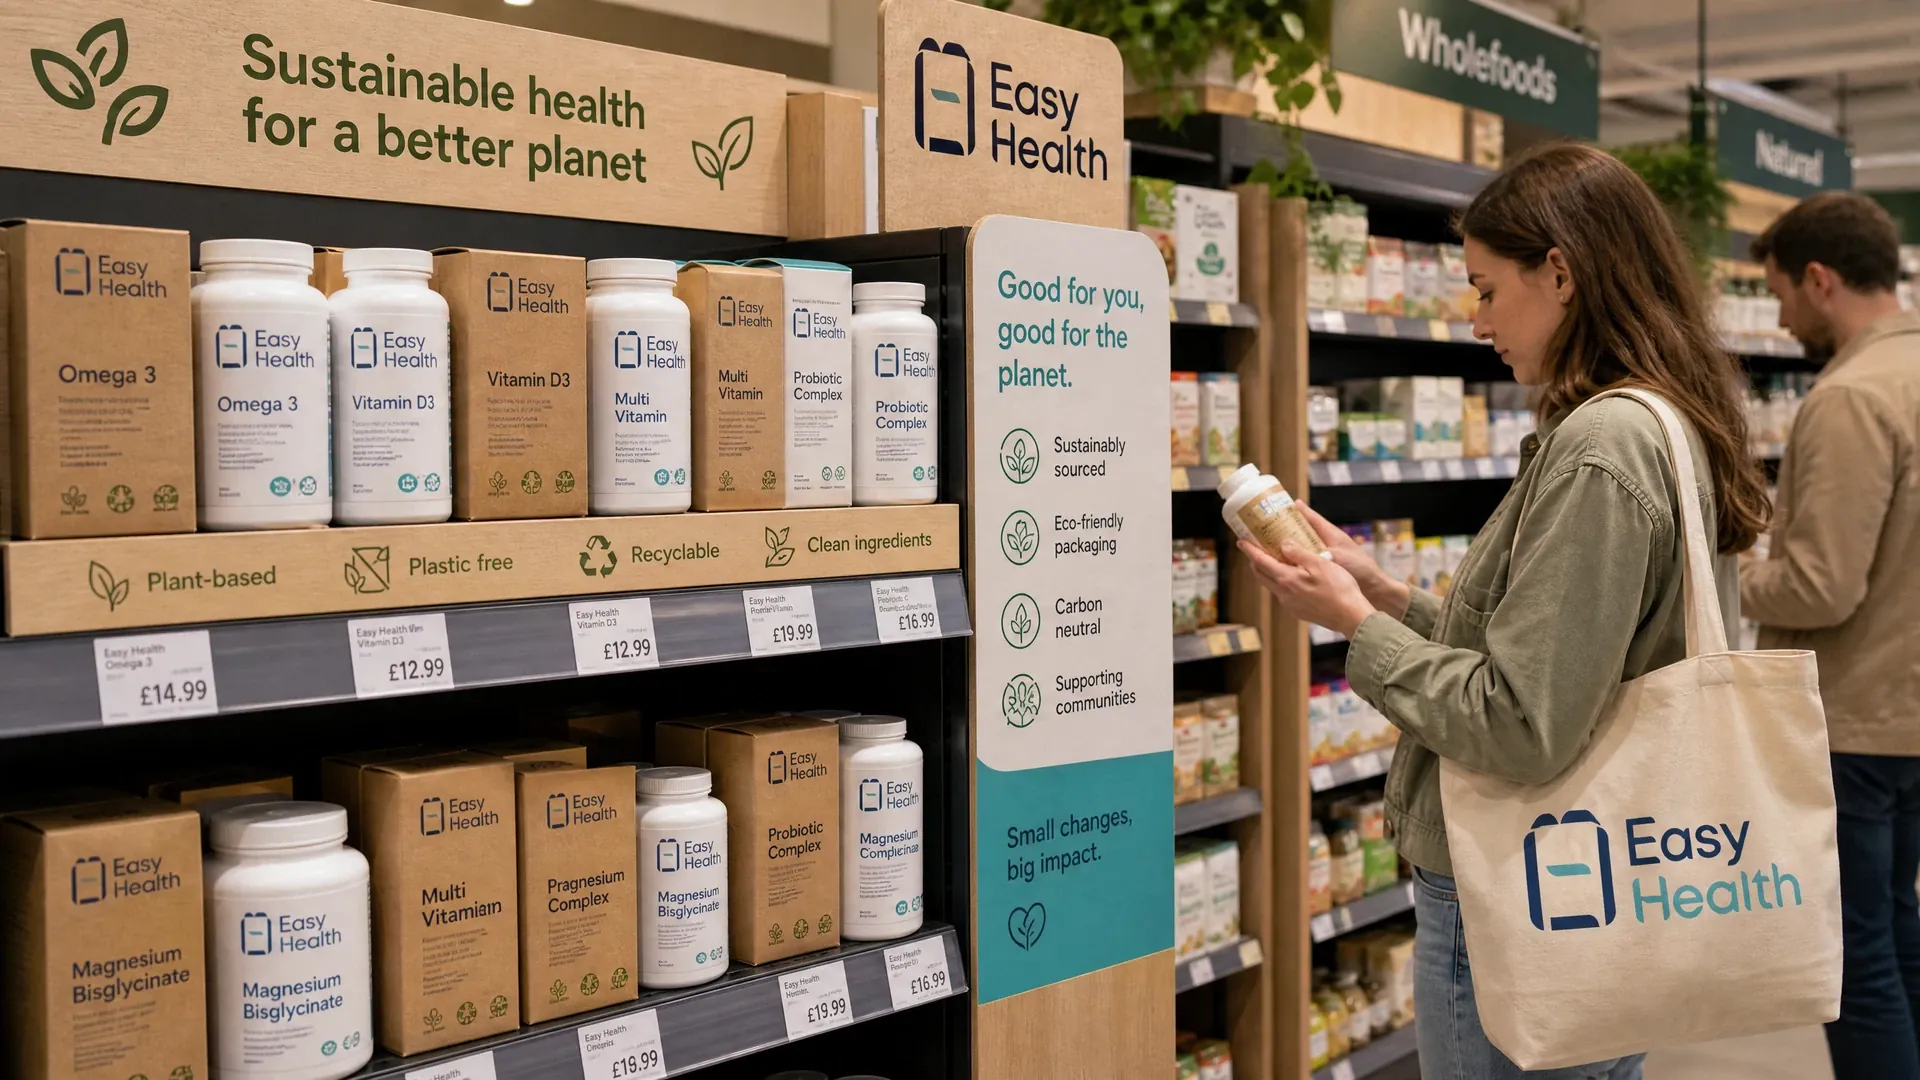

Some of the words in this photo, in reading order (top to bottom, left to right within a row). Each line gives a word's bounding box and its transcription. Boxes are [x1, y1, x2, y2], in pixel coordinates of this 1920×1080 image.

[1398, 6, 1557, 105] Wholefoods
[242, 32, 515, 112] Sustainable
[528, 74, 645, 130] health
[990, 61, 1080, 132] Easy
[242, 96, 317, 148] for
[333, 119, 360, 154] a
[377, 112, 514, 168] better
[528, 133, 647, 184] planet
[991, 118, 1108, 181] Health
[98, 255, 149, 279] Easy
[98, 278, 168, 299] Health
[518, 278, 555, 298] Easy
[998, 269, 1061, 303] Good
[1067, 276, 1097, 305] for
[1103, 287, 1144, 314] you,
[518, 298, 569, 314] Health
[738, 300, 764, 316] Easy
[738, 315, 773, 328] Health
[813, 312, 838, 327] Easy
[255, 329, 301, 351] Easy
[384, 331, 426, 353] Easy
[813, 327, 846, 339] Health
[998, 318, 1055, 350] good
[1061, 318, 1091, 347] for
[1096, 322, 1128, 349] the
[646, 335, 679, 355] Easy
[255, 351, 315, 368] Health
[384, 352, 438, 368] Health
[646, 354, 686, 369] Health
[903, 348, 931, 365] Easy
[58, 364, 137, 388] Omega
[144, 365, 157, 384] 3
[487, 371, 546, 388] Vitamin
[550, 372, 571, 388] D3
[718, 370, 748, 383] Multi
[793, 371, 843, 385] Probiotic
[903, 364, 936, 378] Health
[998, 358, 1073, 393] planet.
[351, 395, 412, 411] Vitamin
[417, 394, 435, 410] D3
[615, 392, 650, 406] Multi
[718, 387, 763, 401] Vitamin
[793, 387, 843, 403] Complex
[217, 396, 282, 416] Omega
[288, 396, 298, 412] 3
[875, 400, 929, 414] Probiotic
[615, 409, 667, 424] Vitamin
[875, 416, 928, 432] Complex
[1054, 436, 1126, 456] Sustainably
[1054, 460, 1106, 477] sourced
[1054, 512, 1124, 531] Eco-friendly
[807, 534, 850, 554] Clean
[854, 531, 933, 555] ingredients
[1054, 537, 1117, 558] packaging
[631, 542, 720, 565] Recyclable
[408, 554, 471, 576] Plastic
[476, 553, 514, 572] free
[147, 565, 277, 593] Plant-based
[749, 597, 764, 606] Easy
[765, 595, 786, 604] Health
[1055, 597, 1103, 615] Carbon
[576, 611, 593, 620] Easy
[595, 608, 620, 617] Health
[577, 620, 606, 629] Vitamin
[606, 618, 617, 627] D3
[899, 612, 935, 631] £16.99
[356, 628, 377, 638] Easy
[379, 625, 407, 636] Health
[773, 623, 813, 643] £19.99
[1055, 618, 1101, 639] neutral
[104, 647, 128, 659] Easy
[131, 643, 166, 656] Health
[357, 638, 391, 648] Vitamin
[392, 636, 405, 646] D3
[603, 638, 651, 660] £12.99
[105, 660, 143, 671] Omega
[388, 658, 444, 682] £12.99
[1055, 669, 1123, 692] Supporting
[139, 679, 207, 706] £14.99
[1055, 689, 1136, 715] communities
[790, 751, 818, 767] Easy
[790, 763, 827, 782] Health
[887, 779, 914, 796] Easy
[449, 797, 485, 814] Easy
[573, 792, 606, 810] Easy
[887, 793, 919, 810] Health
[449, 810, 499, 832] Health
[573, 805, 617, 826] Health
[768, 820, 824, 841] Probiotic
[860, 829, 919, 846] Magnesium
[1007, 818, 1055, 849] Small
[1060, 808, 1133, 837] changes,
[684, 839, 715, 856] Easy
[768, 839, 822, 861] Complex
[1625, 816, 1750, 867] Easy
[112, 856, 162, 877] Easy
[684, 851, 722, 870] Health
[1007, 856, 1035, 883] big
[1040, 842, 1102, 875] impact.
[112, 872, 181, 899] Health
[547, 869, 625, 895] Pragnesium
[421, 881, 466, 906] Multi
[547, 891, 610, 913] Complex
[657, 885, 720, 904] Magnesium
[1631, 862, 1802, 924] Health
[657, 900, 720, 920] Bisglycinate
[279, 914, 327, 933] Easy
[279, 928, 342, 953] Health
[72, 947, 183, 980] Magnesium
[72, 968, 190, 1005] Bisglycinate
[242, 972, 342, 1001] Magnesium
[784, 981, 799, 989] Easy
[800, 974, 820, 985] Health
[911, 970, 946, 995] £16.99
[243, 993, 344, 1023] Bisglycinate
[807, 997, 846, 1023] £19.99
[584, 1033, 601, 1043] Easy
[603, 1025, 627, 1037] Health
